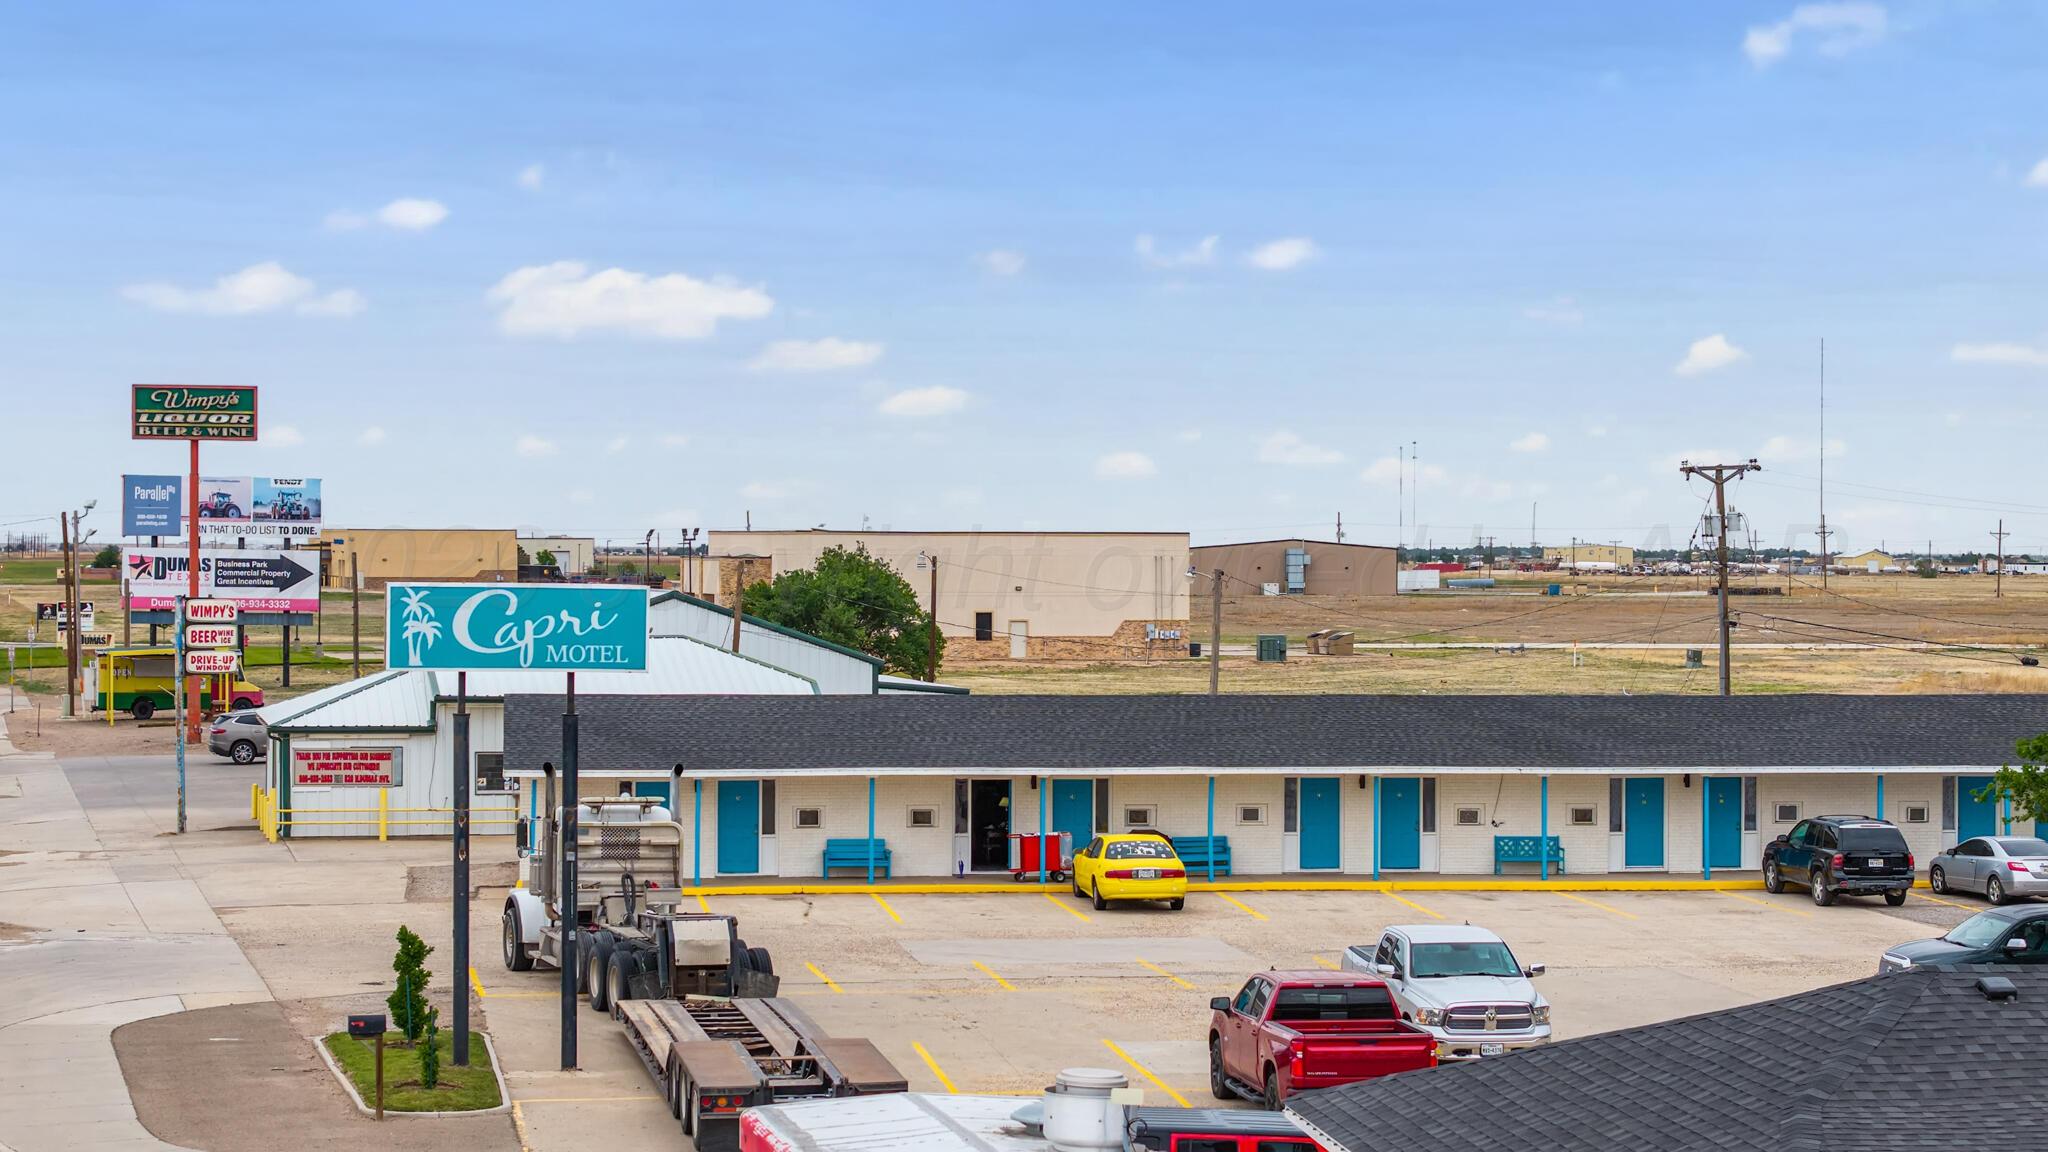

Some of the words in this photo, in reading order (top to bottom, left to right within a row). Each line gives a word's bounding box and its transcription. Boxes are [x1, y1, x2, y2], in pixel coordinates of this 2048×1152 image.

[151, 388, 240, 410] Wimpy's
[138, 413, 251, 424] LIQUOR
[138, 426, 188, 436] BEER
[191, 427, 202, 436] &
[207, 427, 251, 437] WINE
[134, 485, 169, 501] Parallel
[186, 524, 207, 534] TN
[209, 525, 229, 534] THAT
[232, 525, 257, 535] TO-DO
[259, 526, 276, 535] LIST
[279, 526, 290, 535] TO
[292, 526, 318, 535] DONE.
[154, 556, 211, 580] DUMS
[217, 560, 250, 568] Business
[168, 572, 210, 581] TEXS
[217, 569, 259, 577] Commercial
[260, 569, 291, 579] Property
[237, 578, 274, 586] Incentives
[236, 599, 290, 609] 06-934-3332
[191, 604, 235, 618] WIMPY'S
[452, 589, 618, 667] Capri
[191, 630, 217, 643] BEER
[545, 645, 629, 663] MOTEL
[191, 655, 235, 665] DRIVE-UP
